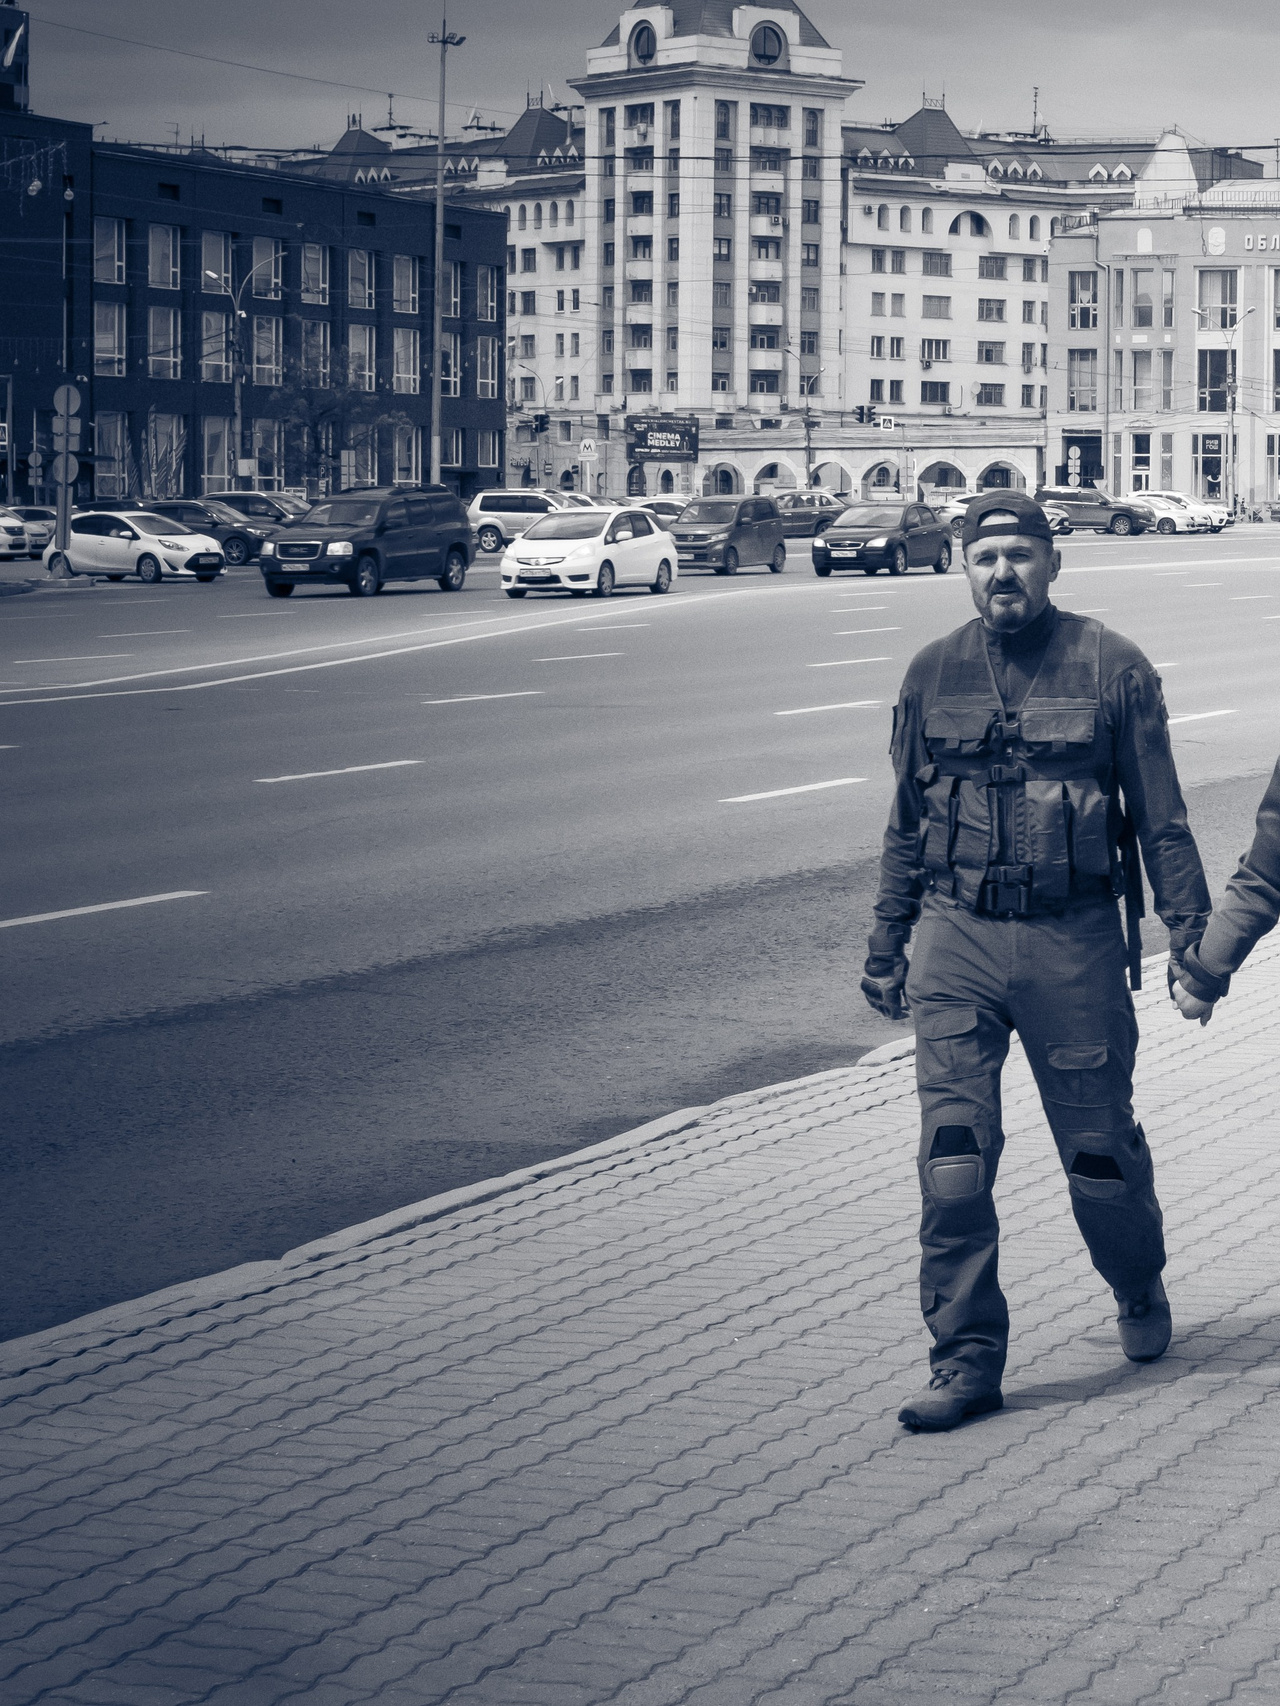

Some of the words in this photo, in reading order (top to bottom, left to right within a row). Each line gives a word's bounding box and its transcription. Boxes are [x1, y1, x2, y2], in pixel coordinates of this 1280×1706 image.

[647, 432, 681, 440] CINEMA
[647, 439, 681, 447] MEDLEY
[320, 467, 325, 477] P
